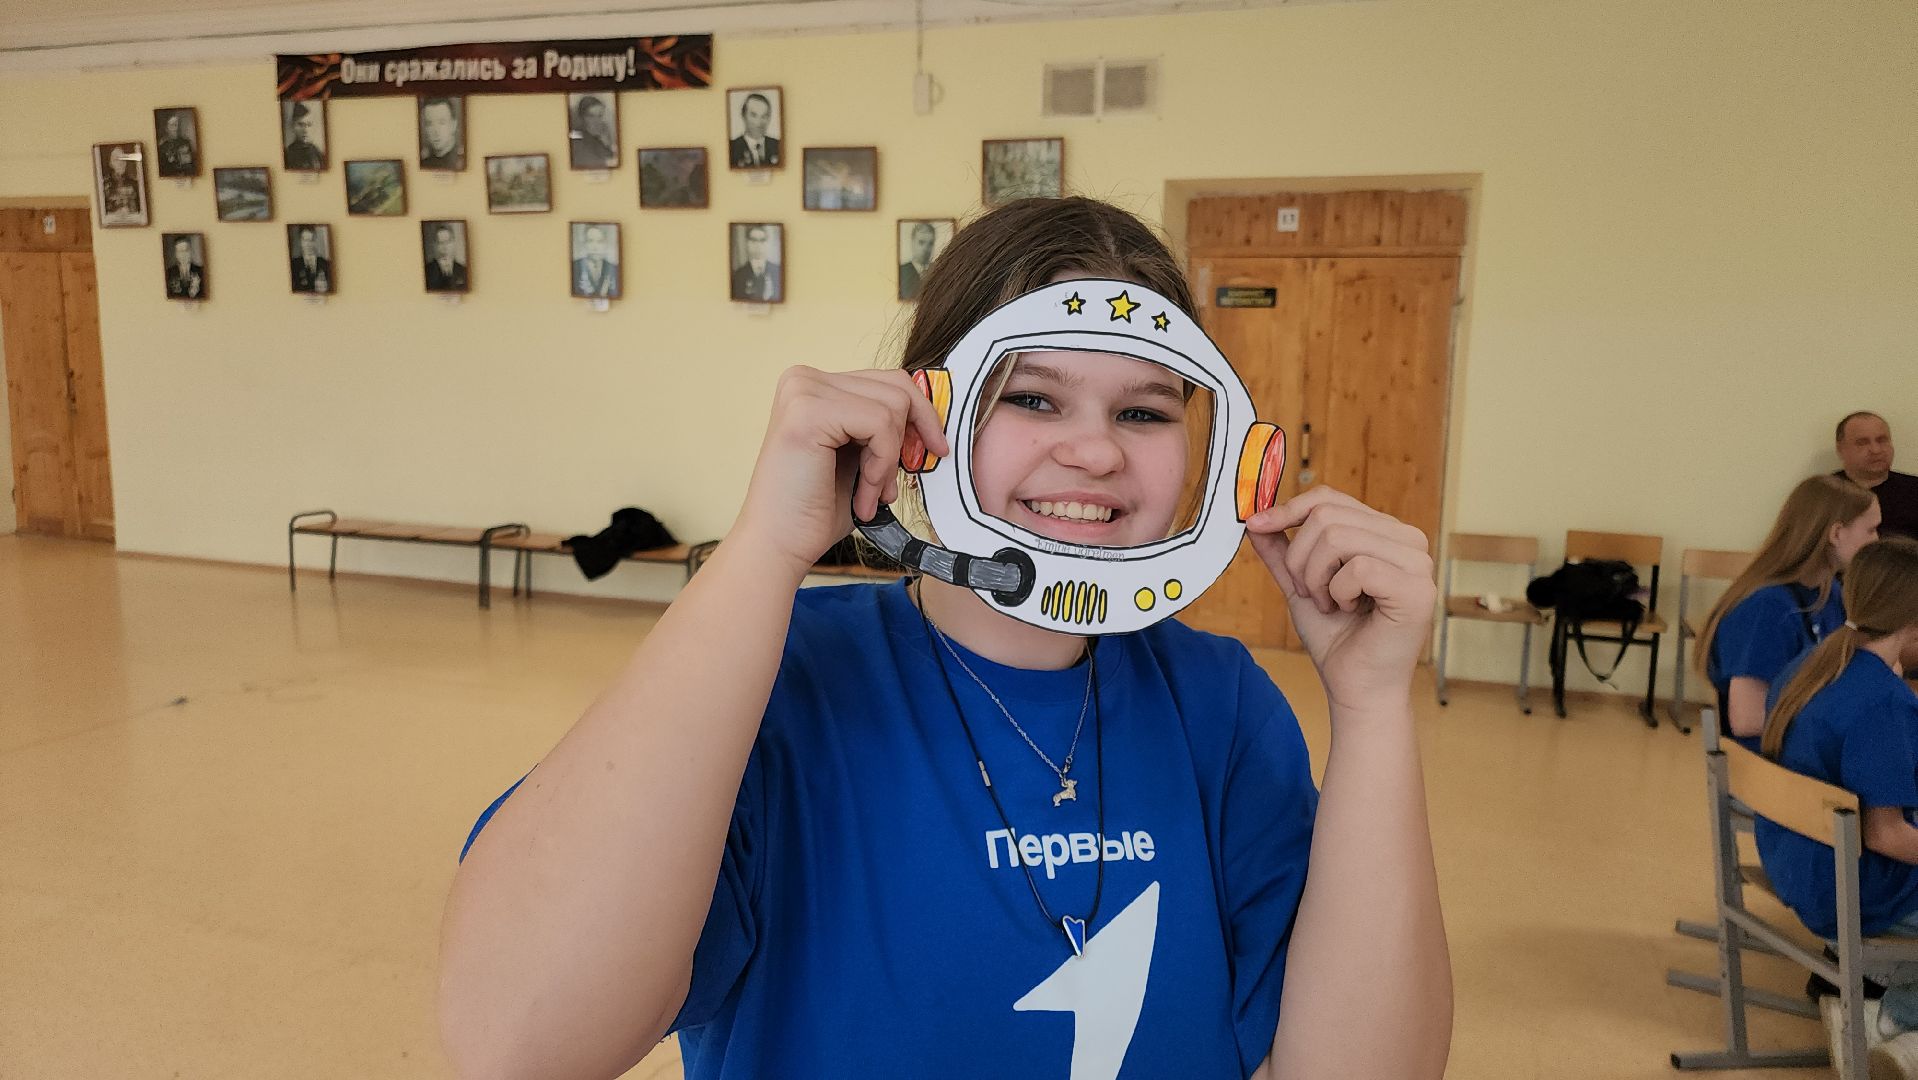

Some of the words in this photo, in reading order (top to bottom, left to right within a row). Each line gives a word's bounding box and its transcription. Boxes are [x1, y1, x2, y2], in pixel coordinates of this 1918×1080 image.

[340, 57, 380, 84] Они
[384, 57, 506, 87] сражались
[511, 56, 538, 80] за
[543, 46, 636, 82] Родину!
[985, 827, 1156, 879] Первые
